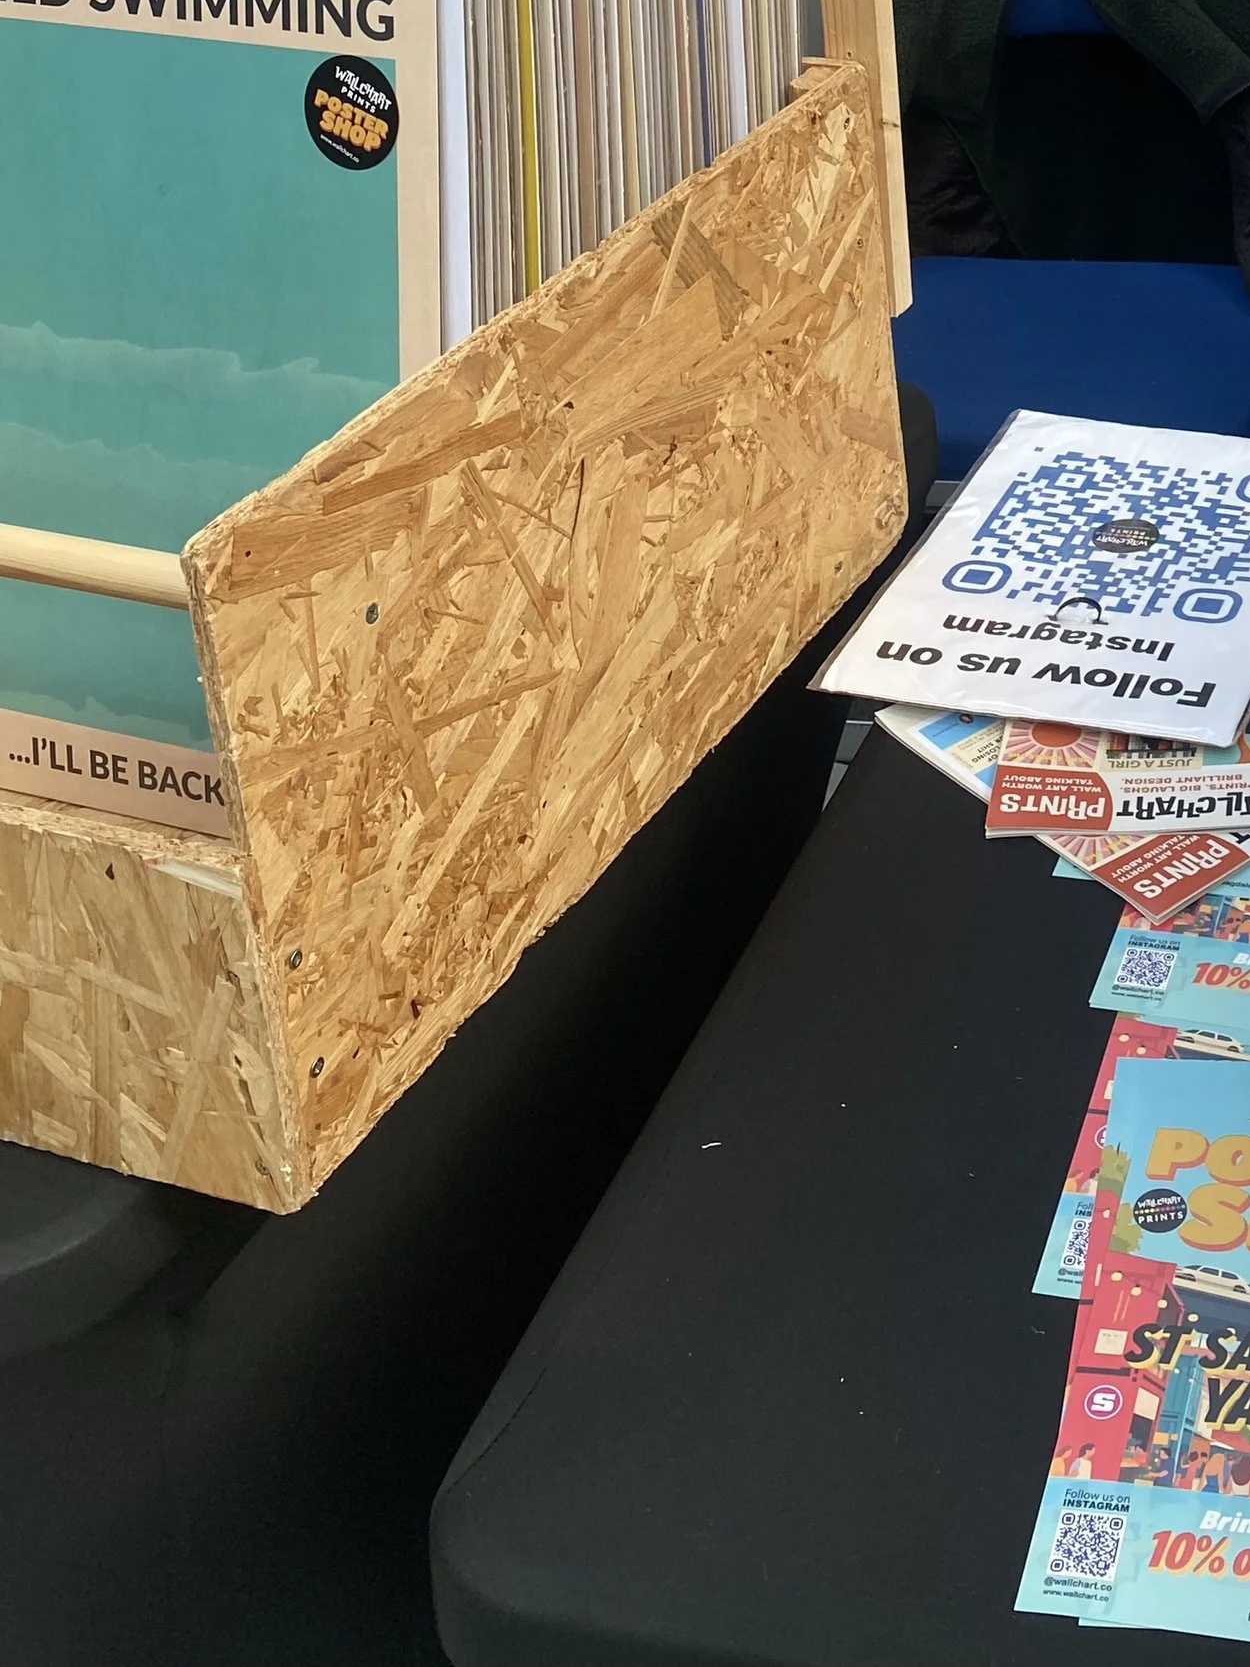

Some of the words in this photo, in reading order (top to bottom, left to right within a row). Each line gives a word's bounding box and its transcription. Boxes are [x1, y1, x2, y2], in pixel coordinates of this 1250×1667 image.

[335, 66, 392, 110] WALLCHART
[341, 86, 376, 113] PRINTS
[314, 89, 388, 140] POSTER
[320, 110, 381, 152] SHOP
[876, 641, 943, 665] on
[943, 614, 1174, 662] Instagram
[956, 653, 1021, 675] us
[1032, 662, 1216, 708] Follow
[90, 750, 129, 785] BE
[138, 760, 225, 806] BACK
[1000, 794, 1106, 820] PRINTS
[1125, 1323, 1197, 1369] ST
[1063, 1499, 1130, 1513] INSTAGRAM
[1065, 1488, 1100, 1499] Follow
[1116, 1495, 1130, 1504] on
[1148, 1530, 1229, 1574] 10%
